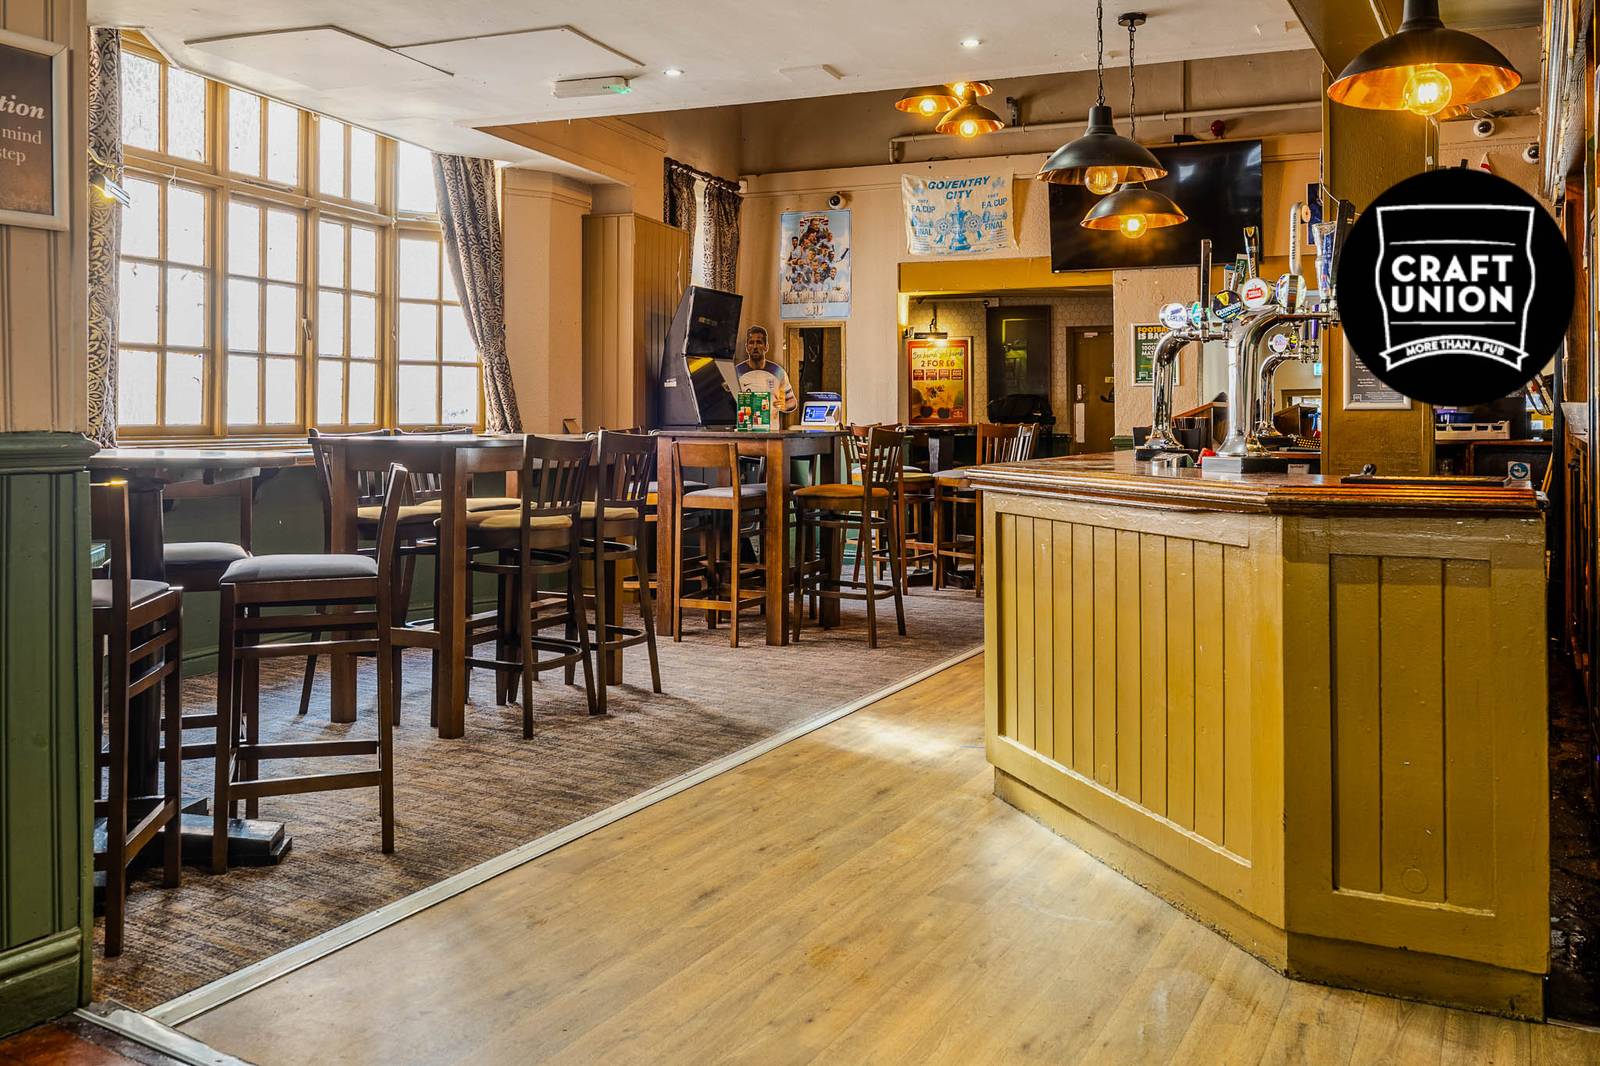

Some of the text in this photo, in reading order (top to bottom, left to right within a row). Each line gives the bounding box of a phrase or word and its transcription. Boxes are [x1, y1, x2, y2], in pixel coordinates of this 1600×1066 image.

[2, 126, 42, 145] mind
[928, 175, 991, 190] COVENTRY
[945, 189, 973, 200] CITY
[993, 197, 1008, 207] CUP
[922, 205, 936, 213] CUP
[985, 220, 1004, 230] FINAL
[1147, 332, 1165, 340] BAC
[927, 359, 945, 367] FOR
[946, 359, 956, 367] £6
